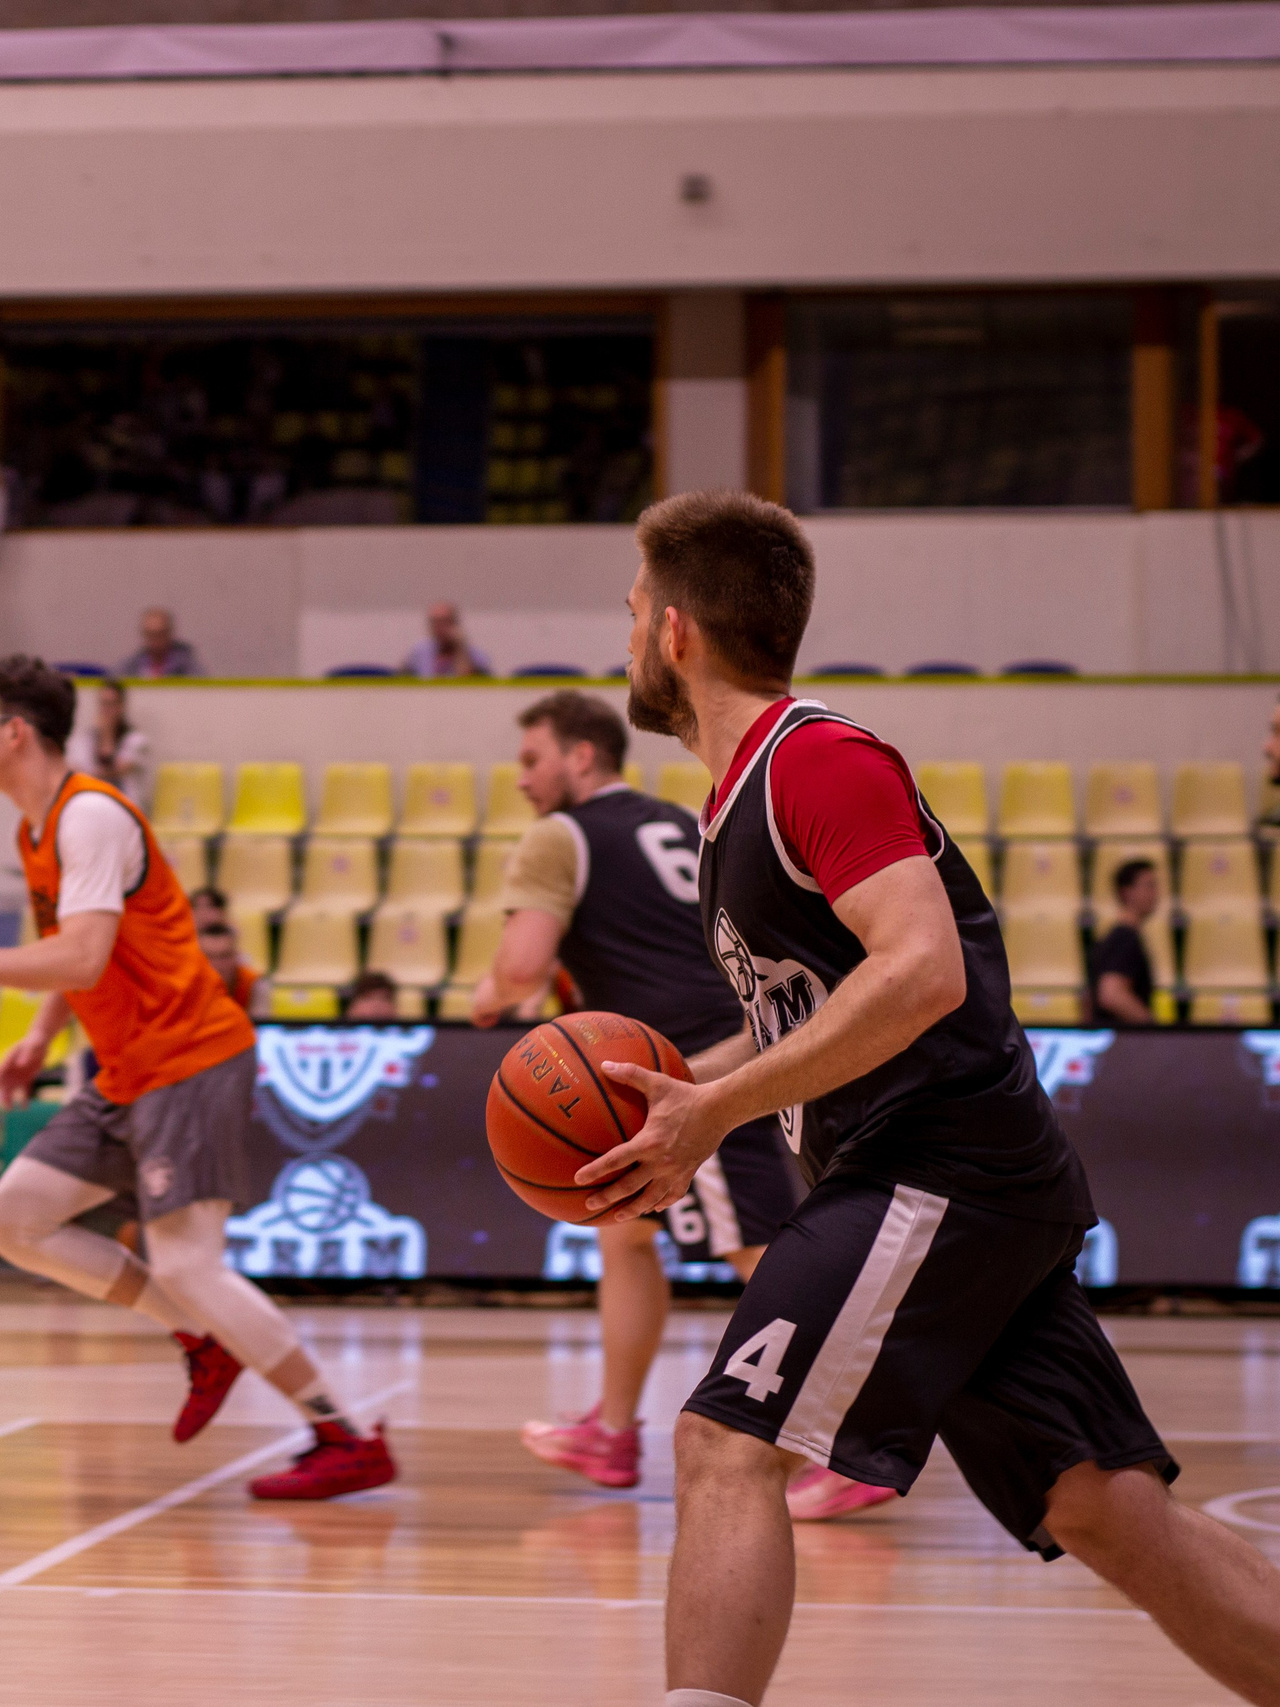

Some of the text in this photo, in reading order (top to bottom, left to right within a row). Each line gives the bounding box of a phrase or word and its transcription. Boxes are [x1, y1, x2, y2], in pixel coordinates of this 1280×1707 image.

[636, 821, 700, 904] 6
[668, 1193, 707, 1246] 6
[723, 1317, 798, 1403] 4
